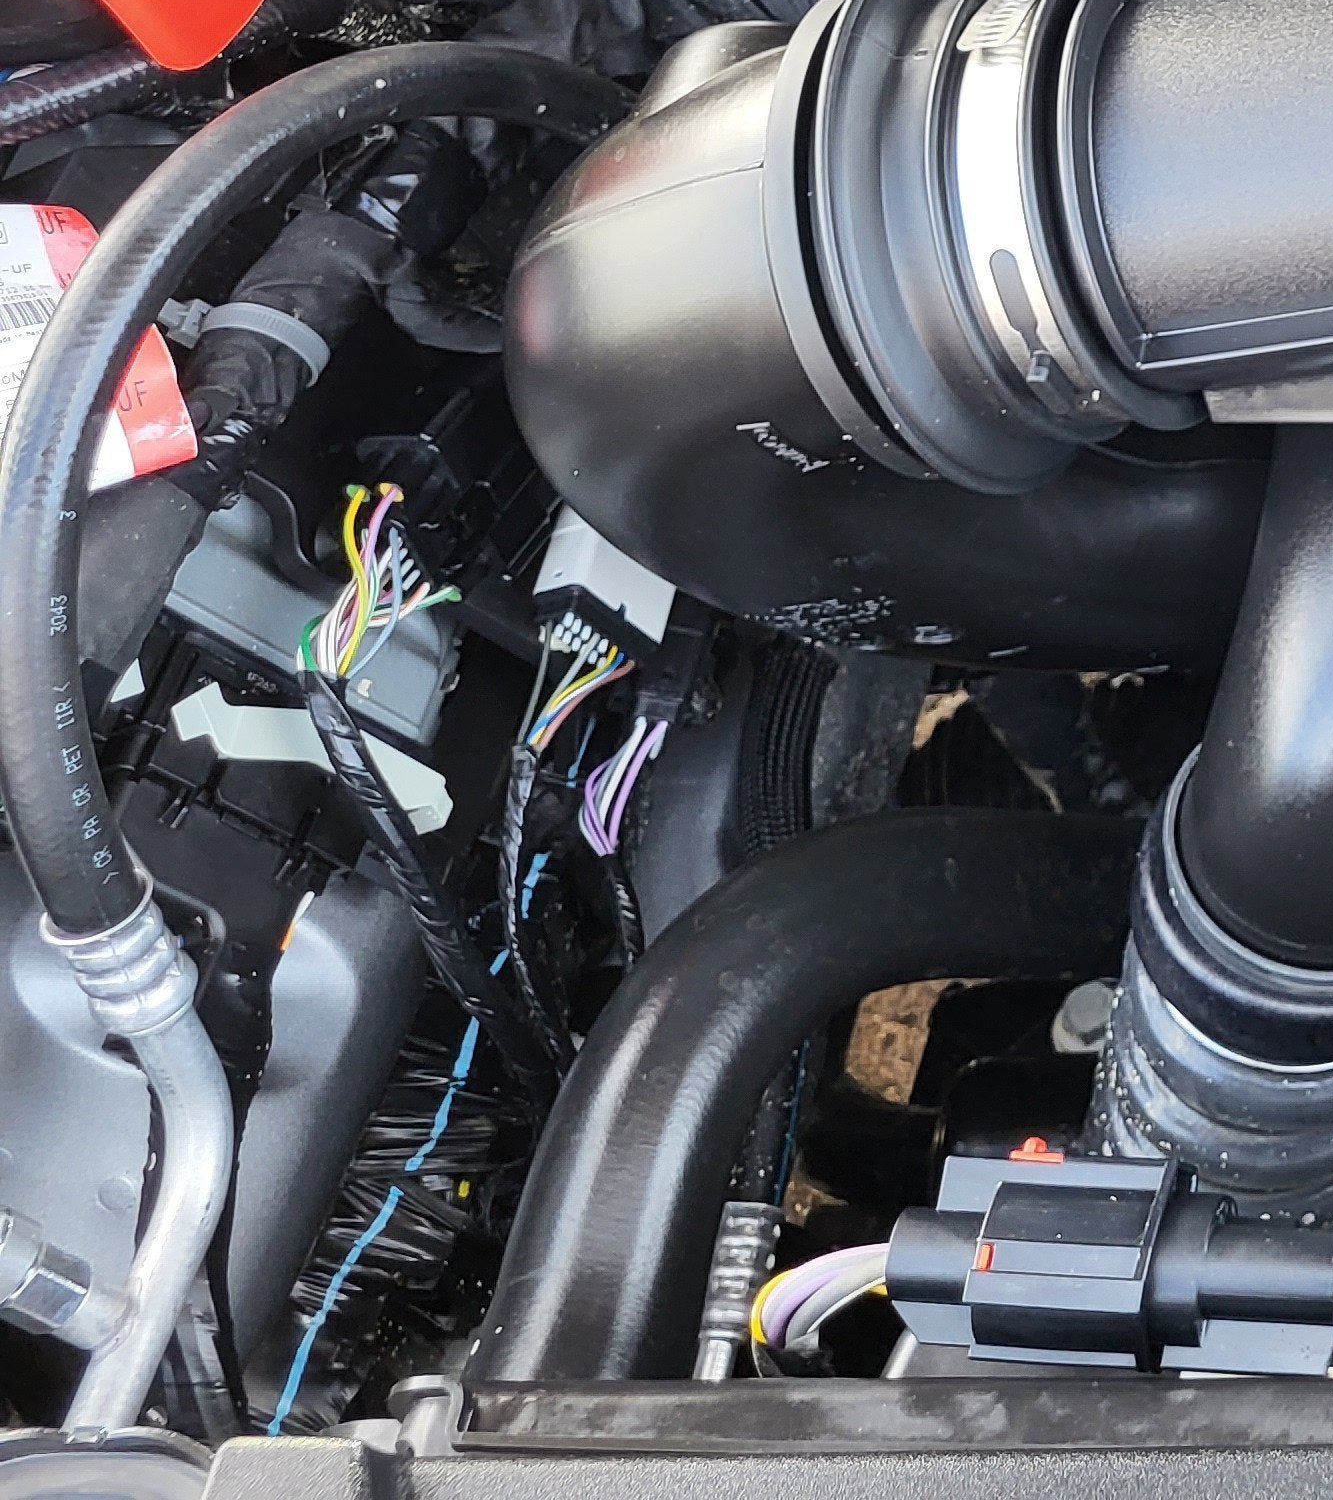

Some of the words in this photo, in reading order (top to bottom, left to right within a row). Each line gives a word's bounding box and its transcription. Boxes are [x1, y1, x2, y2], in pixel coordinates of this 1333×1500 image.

[36, 210, 67, 235] UF
[118, 380, 148, 403] UF
[49, 594, 68, 637] 3043
[61, 743, 84, 776] PET
